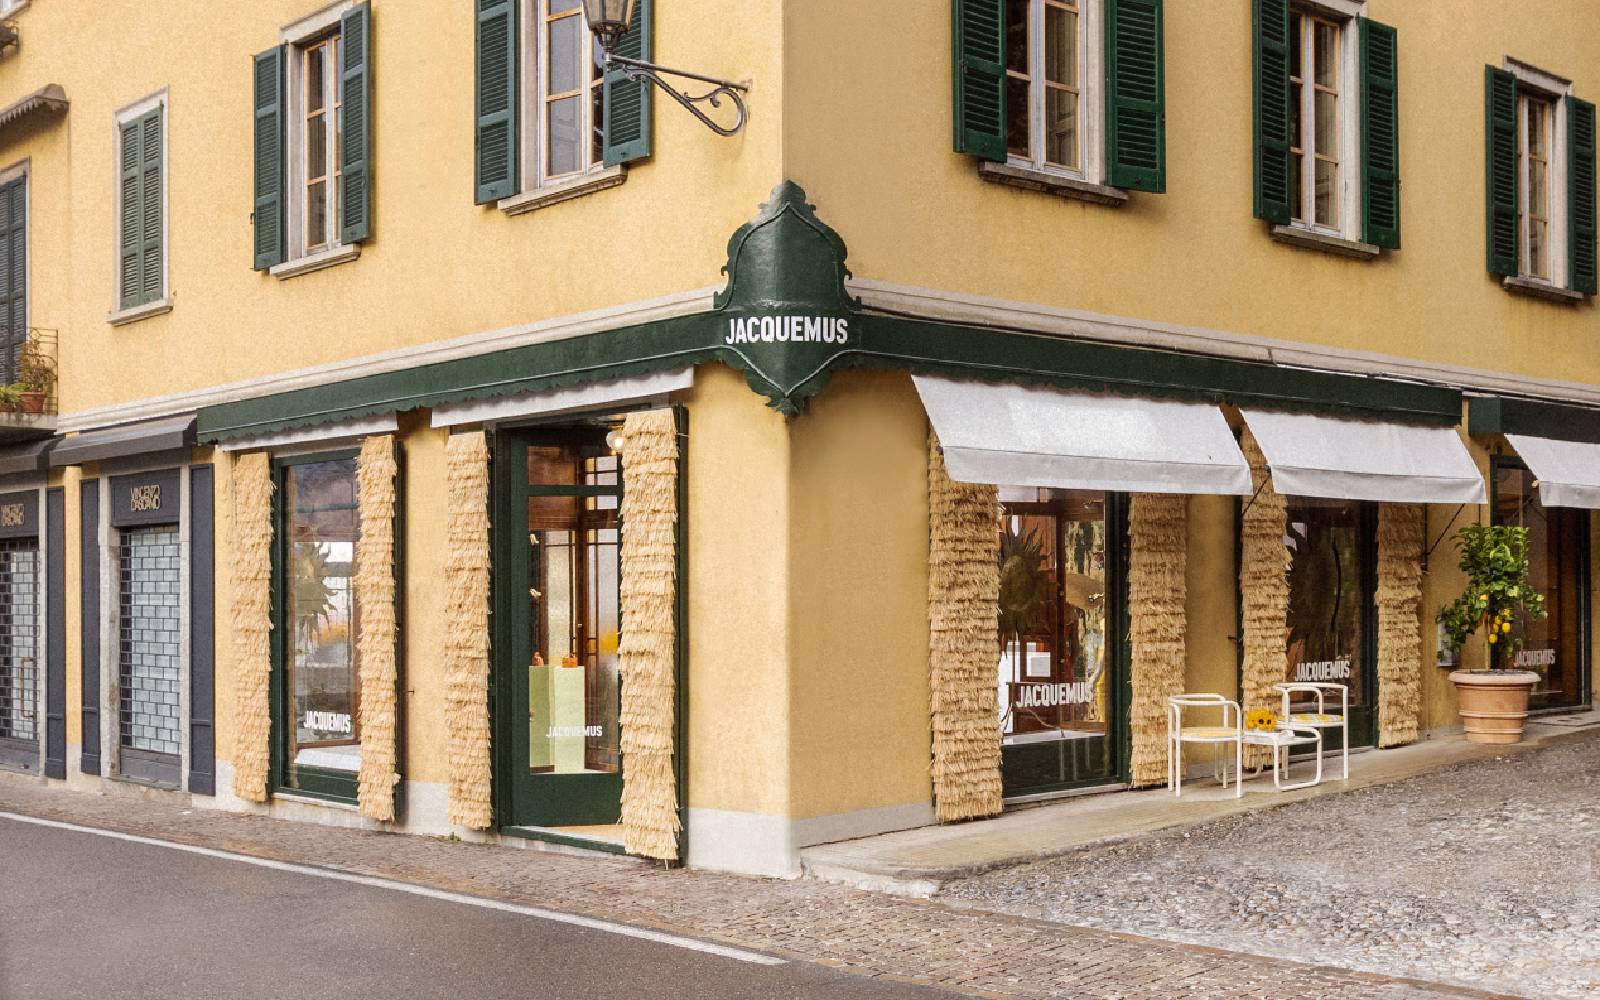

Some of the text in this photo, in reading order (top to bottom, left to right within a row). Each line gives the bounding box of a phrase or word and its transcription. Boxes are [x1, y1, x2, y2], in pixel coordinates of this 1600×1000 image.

[725, 315, 848, 344] JACQUEMUS
[1295, 660, 1350, 682] JACQUEMUS
[1015, 681, 1094, 708] JACQUEMUS
[303, 710, 351, 734] JACQUEMUS
